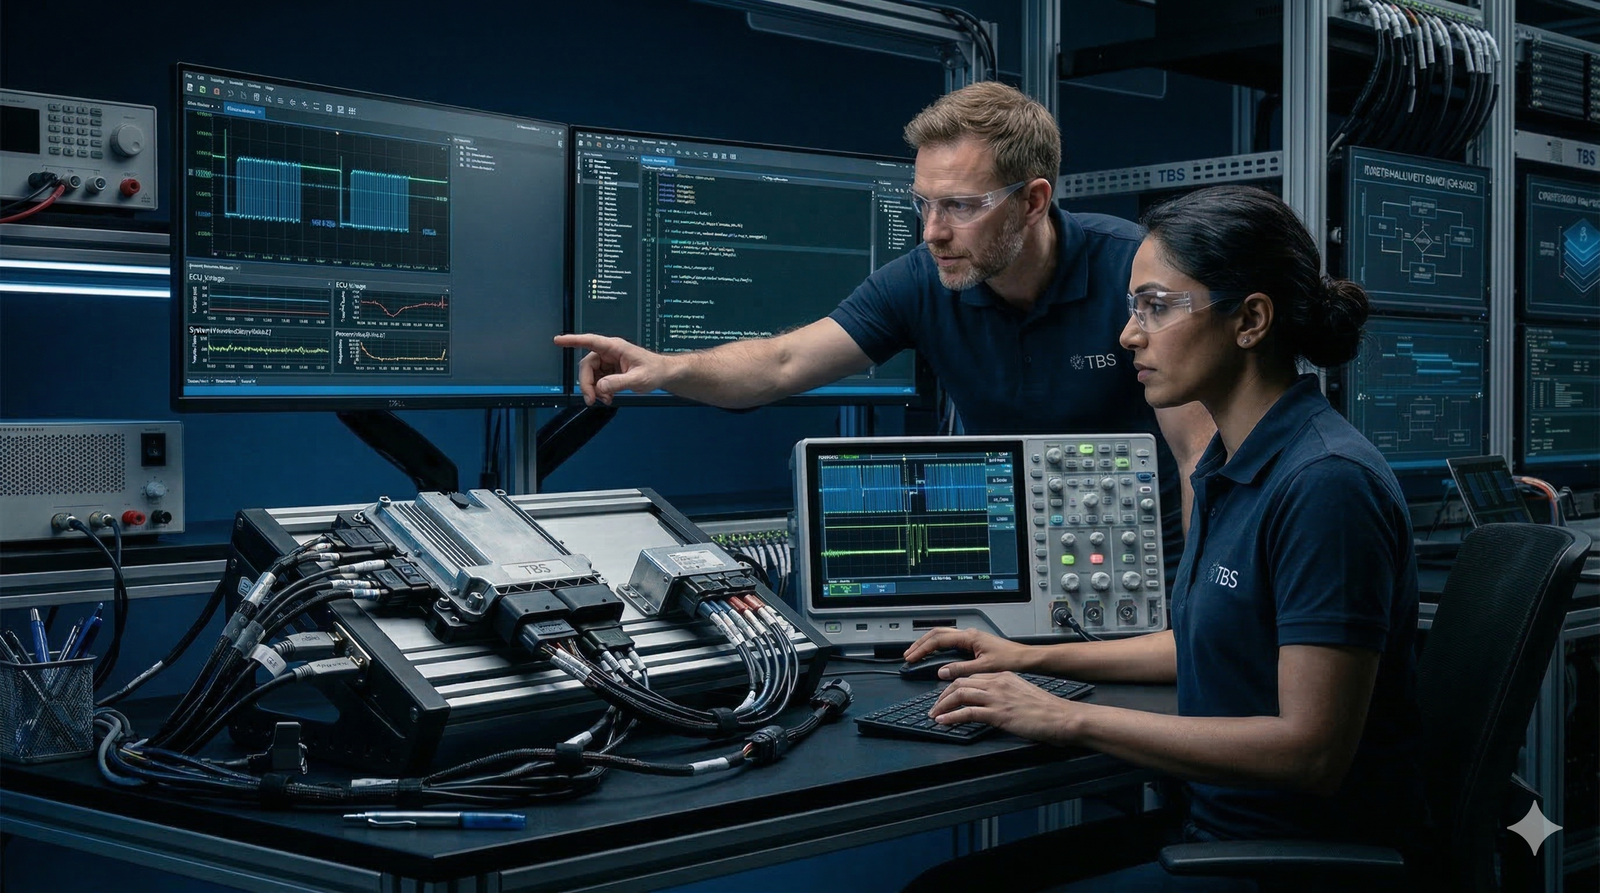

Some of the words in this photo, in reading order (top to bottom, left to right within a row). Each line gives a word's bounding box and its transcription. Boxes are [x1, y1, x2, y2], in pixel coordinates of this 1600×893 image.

[1577, 148, 1596, 166] TBS
[1158, 168, 1185, 183] TBS
[1084, 354, 1117, 369] TBS
[518, 563, 551, 575] TBS
[1215, 565, 1239, 588] TBS
